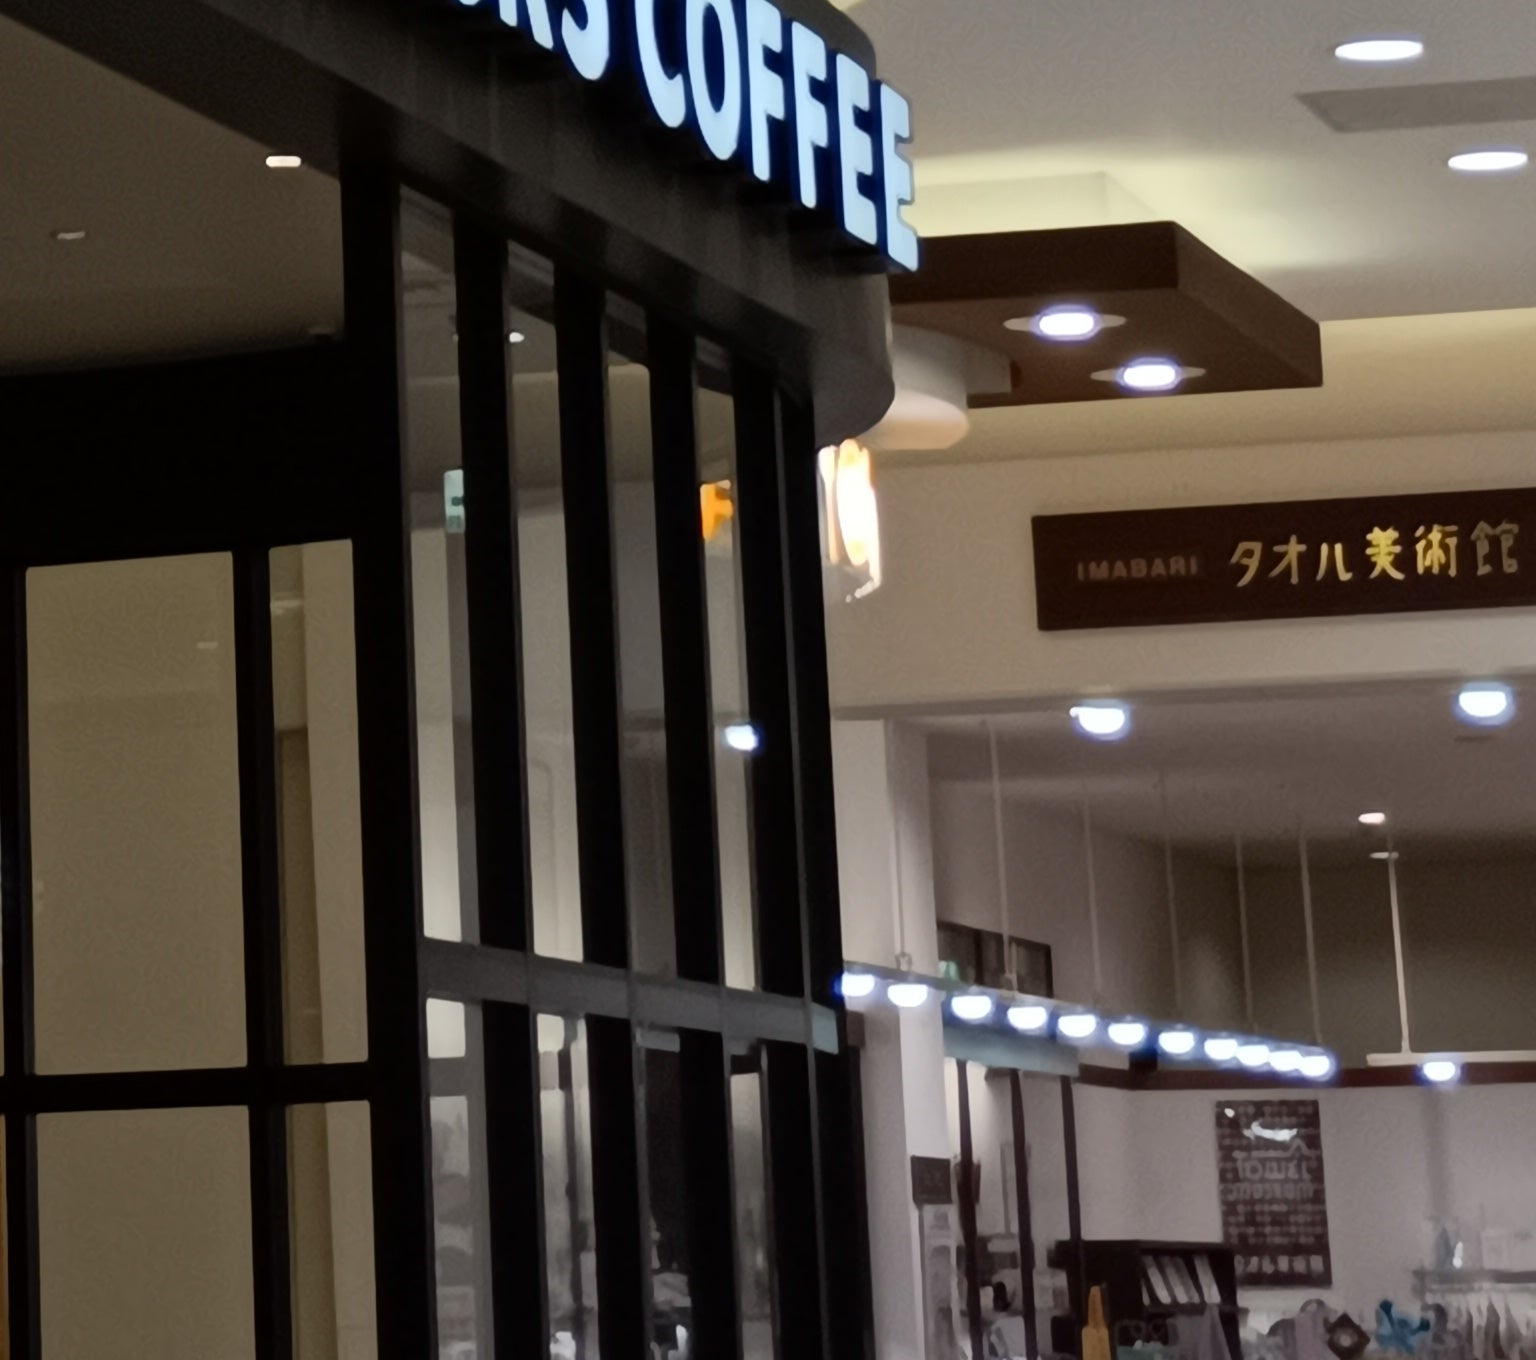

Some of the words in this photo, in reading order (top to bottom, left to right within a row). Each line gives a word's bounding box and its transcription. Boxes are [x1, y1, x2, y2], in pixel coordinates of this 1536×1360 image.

[1077, 555, 1199, 581] IMABARI
[1230, 520, 1520, 587] タオル美術館
